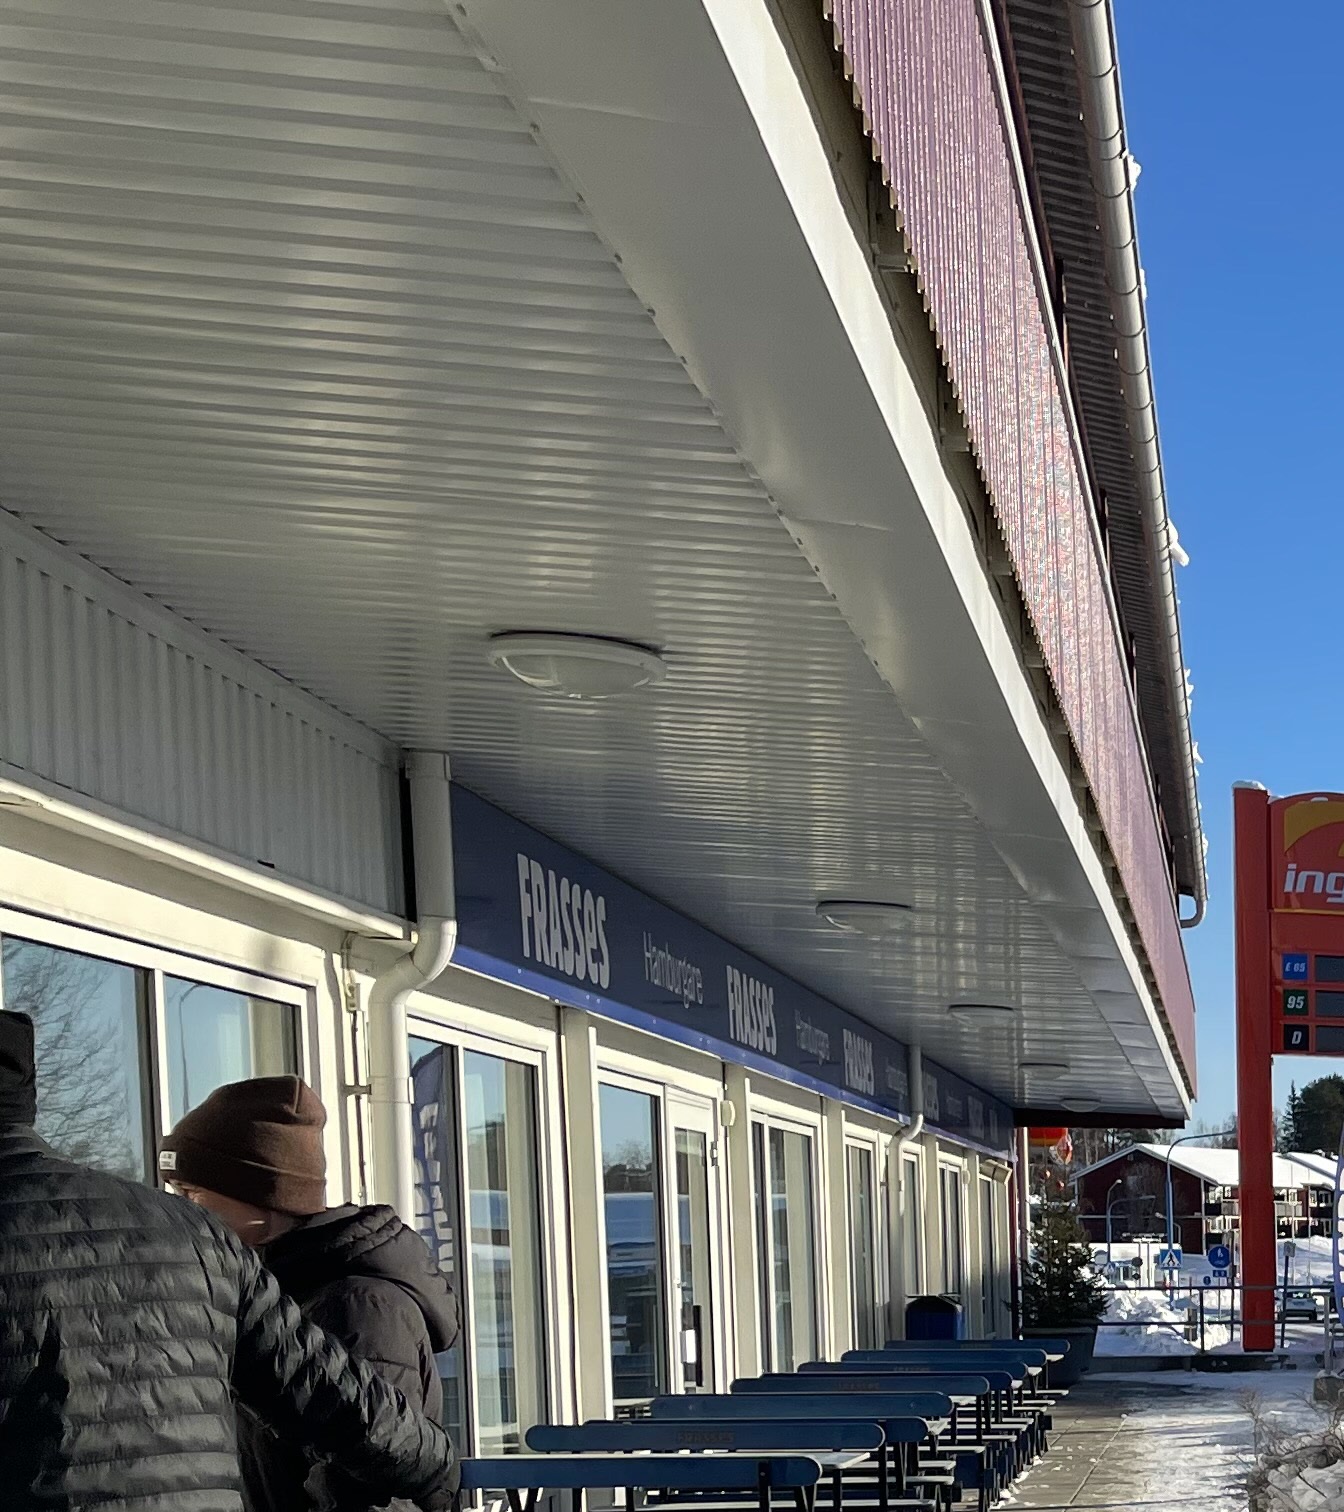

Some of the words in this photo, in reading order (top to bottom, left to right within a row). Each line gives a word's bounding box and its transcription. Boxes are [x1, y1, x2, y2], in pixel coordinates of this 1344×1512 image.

[643, 931, 703, 1009] Hamburgare
[1286, 995, 1305, 1009] 95
[1291, 1030, 1302, 1045] D
